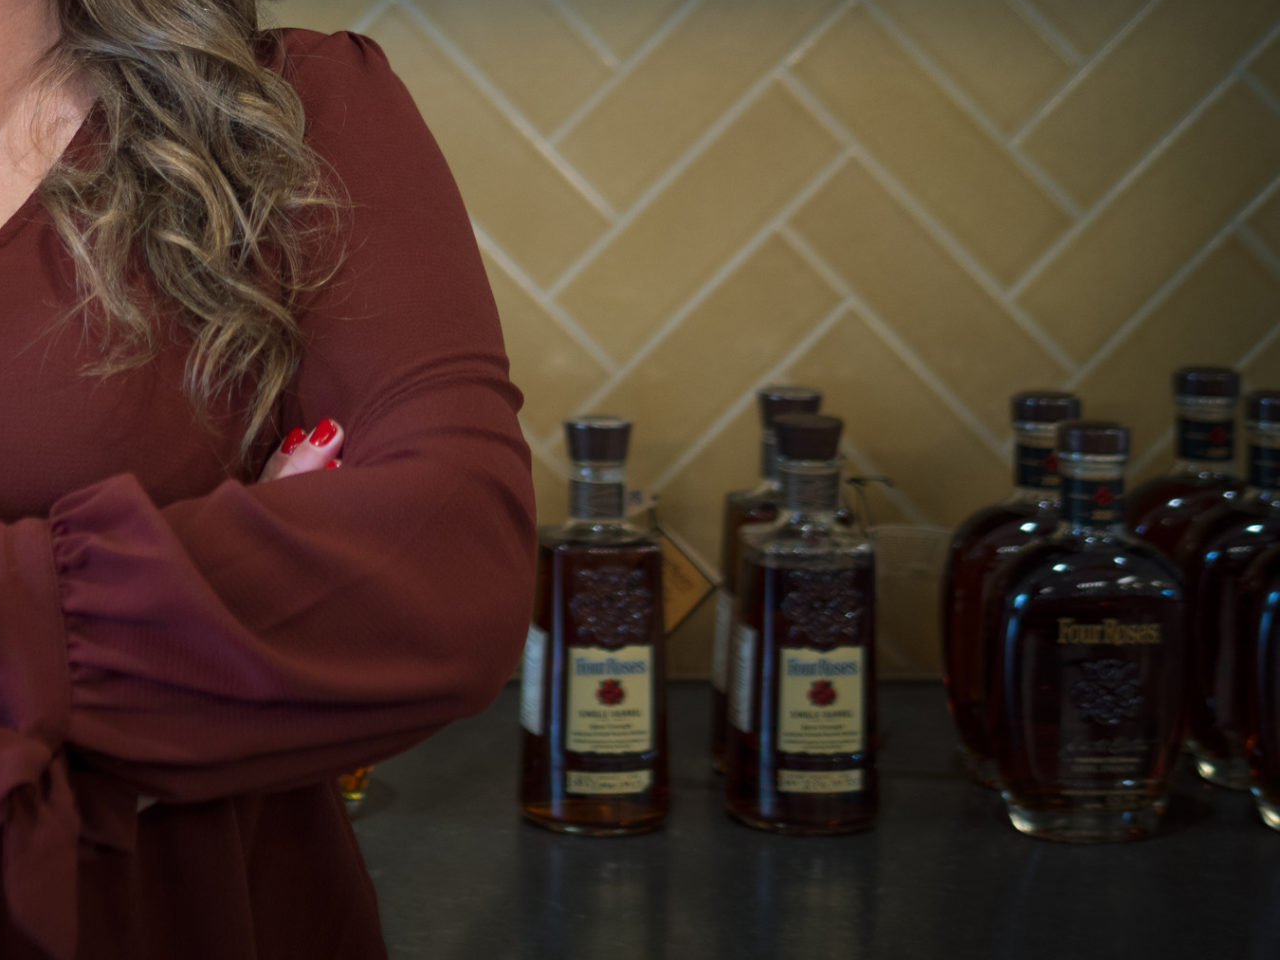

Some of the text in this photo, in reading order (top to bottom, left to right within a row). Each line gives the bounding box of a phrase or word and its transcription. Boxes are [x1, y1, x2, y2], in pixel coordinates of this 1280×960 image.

[1056, 617, 1162, 646] Four Roses
[576, 657, 646, 675] Four Roses
[787, 658, 858, 675] Four Roses
